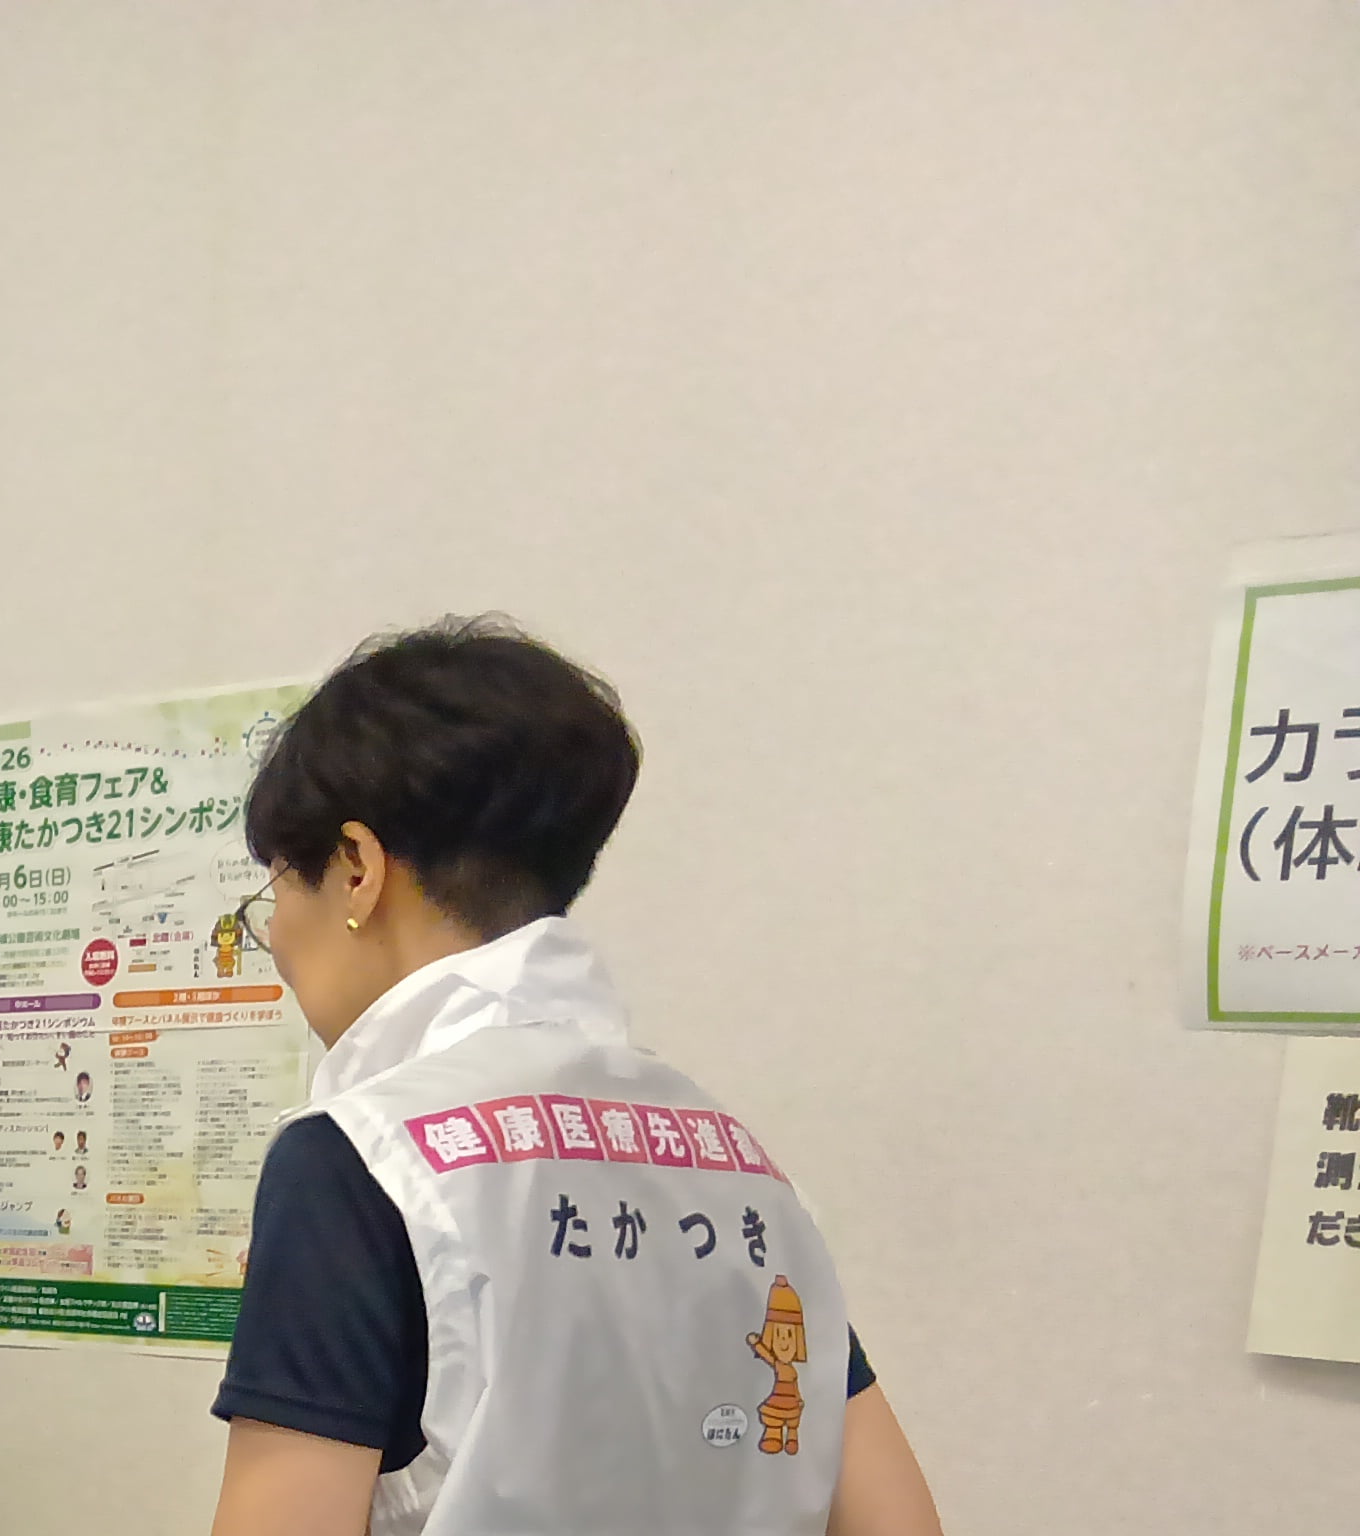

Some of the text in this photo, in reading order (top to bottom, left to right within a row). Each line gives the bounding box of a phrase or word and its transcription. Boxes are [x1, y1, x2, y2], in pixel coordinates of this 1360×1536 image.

[1239, 804, 1360, 881] (体
[1314, 1151, 1360, 1190] 測
[550, 1194, 768, 1267] たかつき
